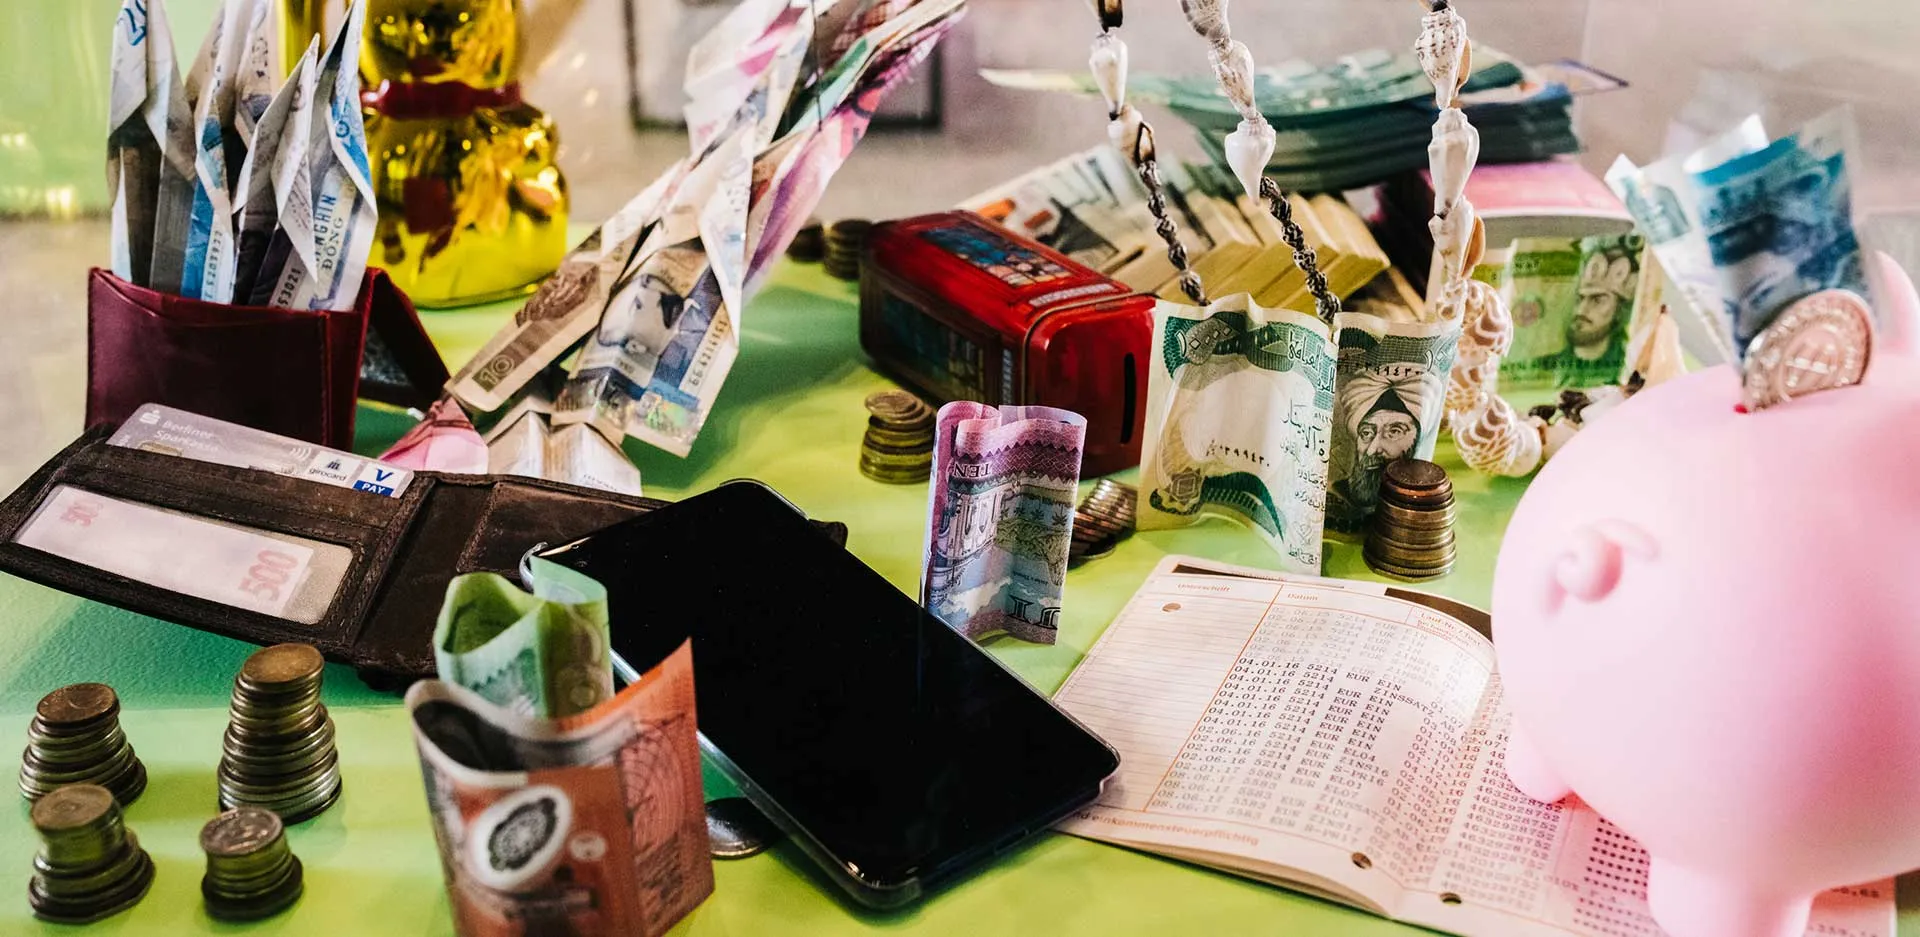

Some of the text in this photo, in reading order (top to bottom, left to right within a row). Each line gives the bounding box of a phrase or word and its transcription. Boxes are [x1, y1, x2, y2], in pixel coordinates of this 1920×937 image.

[277, 267, 302, 307] 53021
[162, 420, 214, 440] Berliner
[309, 468, 348, 482] girocard
[376, 468, 394, 483] V
[954, 462, 992, 479] TEN
[361, 482, 387, 495] PAY
[238, 549, 299, 602] 500
[1287, 593, 1318, 601] Datum
[1230, 673, 1290, 686] 04.01.16
[1298, 679, 1330, 691] 5214
[1335, 687, 1362, 699] EUR
[1369, 694, 1394, 708] EIN
[1239, 657, 1300, 670] 04.01.16
[1306, 663, 1338, 675] 5214
[1345, 671, 1370, 683] EUR
[1377, 678, 1401, 692] EIN
[1220, 689, 1280, 703] 04.01.16
[1289, 695, 1321, 708] 5214
[1327, 704, 1353, 716] EUR
[1361, 711, 1386, 725] EIN
[1225, 681, 1287, 694] 04.01.16
[1293, 687, 1325, 700] 5214
[1331, 695, 1358, 708] EUR
[1365, 702, 1390, 716] EIN
[1235, 665, 1295, 678] 04.01.16
[1302, 671, 1335, 683] 5214
[1373, 686, 1434, 718] ZINSSATZ
[1209, 706, 1270, 719] 04.01.16
[1278, 712, 1311, 725] 5214
[1318, 721, 1345, 734] EUR
[1352, 728, 1377, 742] EIN
[1214, 698, 1276, 711] 04.01.16
[1284, 703, 1317, 717] 5214
[1323, 713, 1350, 725] EUR
[1356, 720, 1381, 733] EIN
[1193, 733, 1256, 747] 02.06.16
[1263, 740, 1298, 752] 5214
[1304, 748, 1331, 761] EUR
[1199, 724, 1261, 738] 02.06.16
[1268, 731, 1302, 743] 5214
[1309, 739, 1336, 752] EUR
[1204, 715, 1266, 728] 04.01.16
[1273, 721, 1307, 734] 5214
[1313, 730, 1341, 743] EUR
[1348, 738, 1373, 752] EIN
[1181, 751, 1246, 765] 02.06.16
[1253, 759, 1287, 771] 5214
[1294, 767, 1321, 780] EUR
[1187, 742, 1251, 756] 02.06.16
[1258, 749, 1292, 761] 5214
[1299, 757, 1326, 770] EUR
